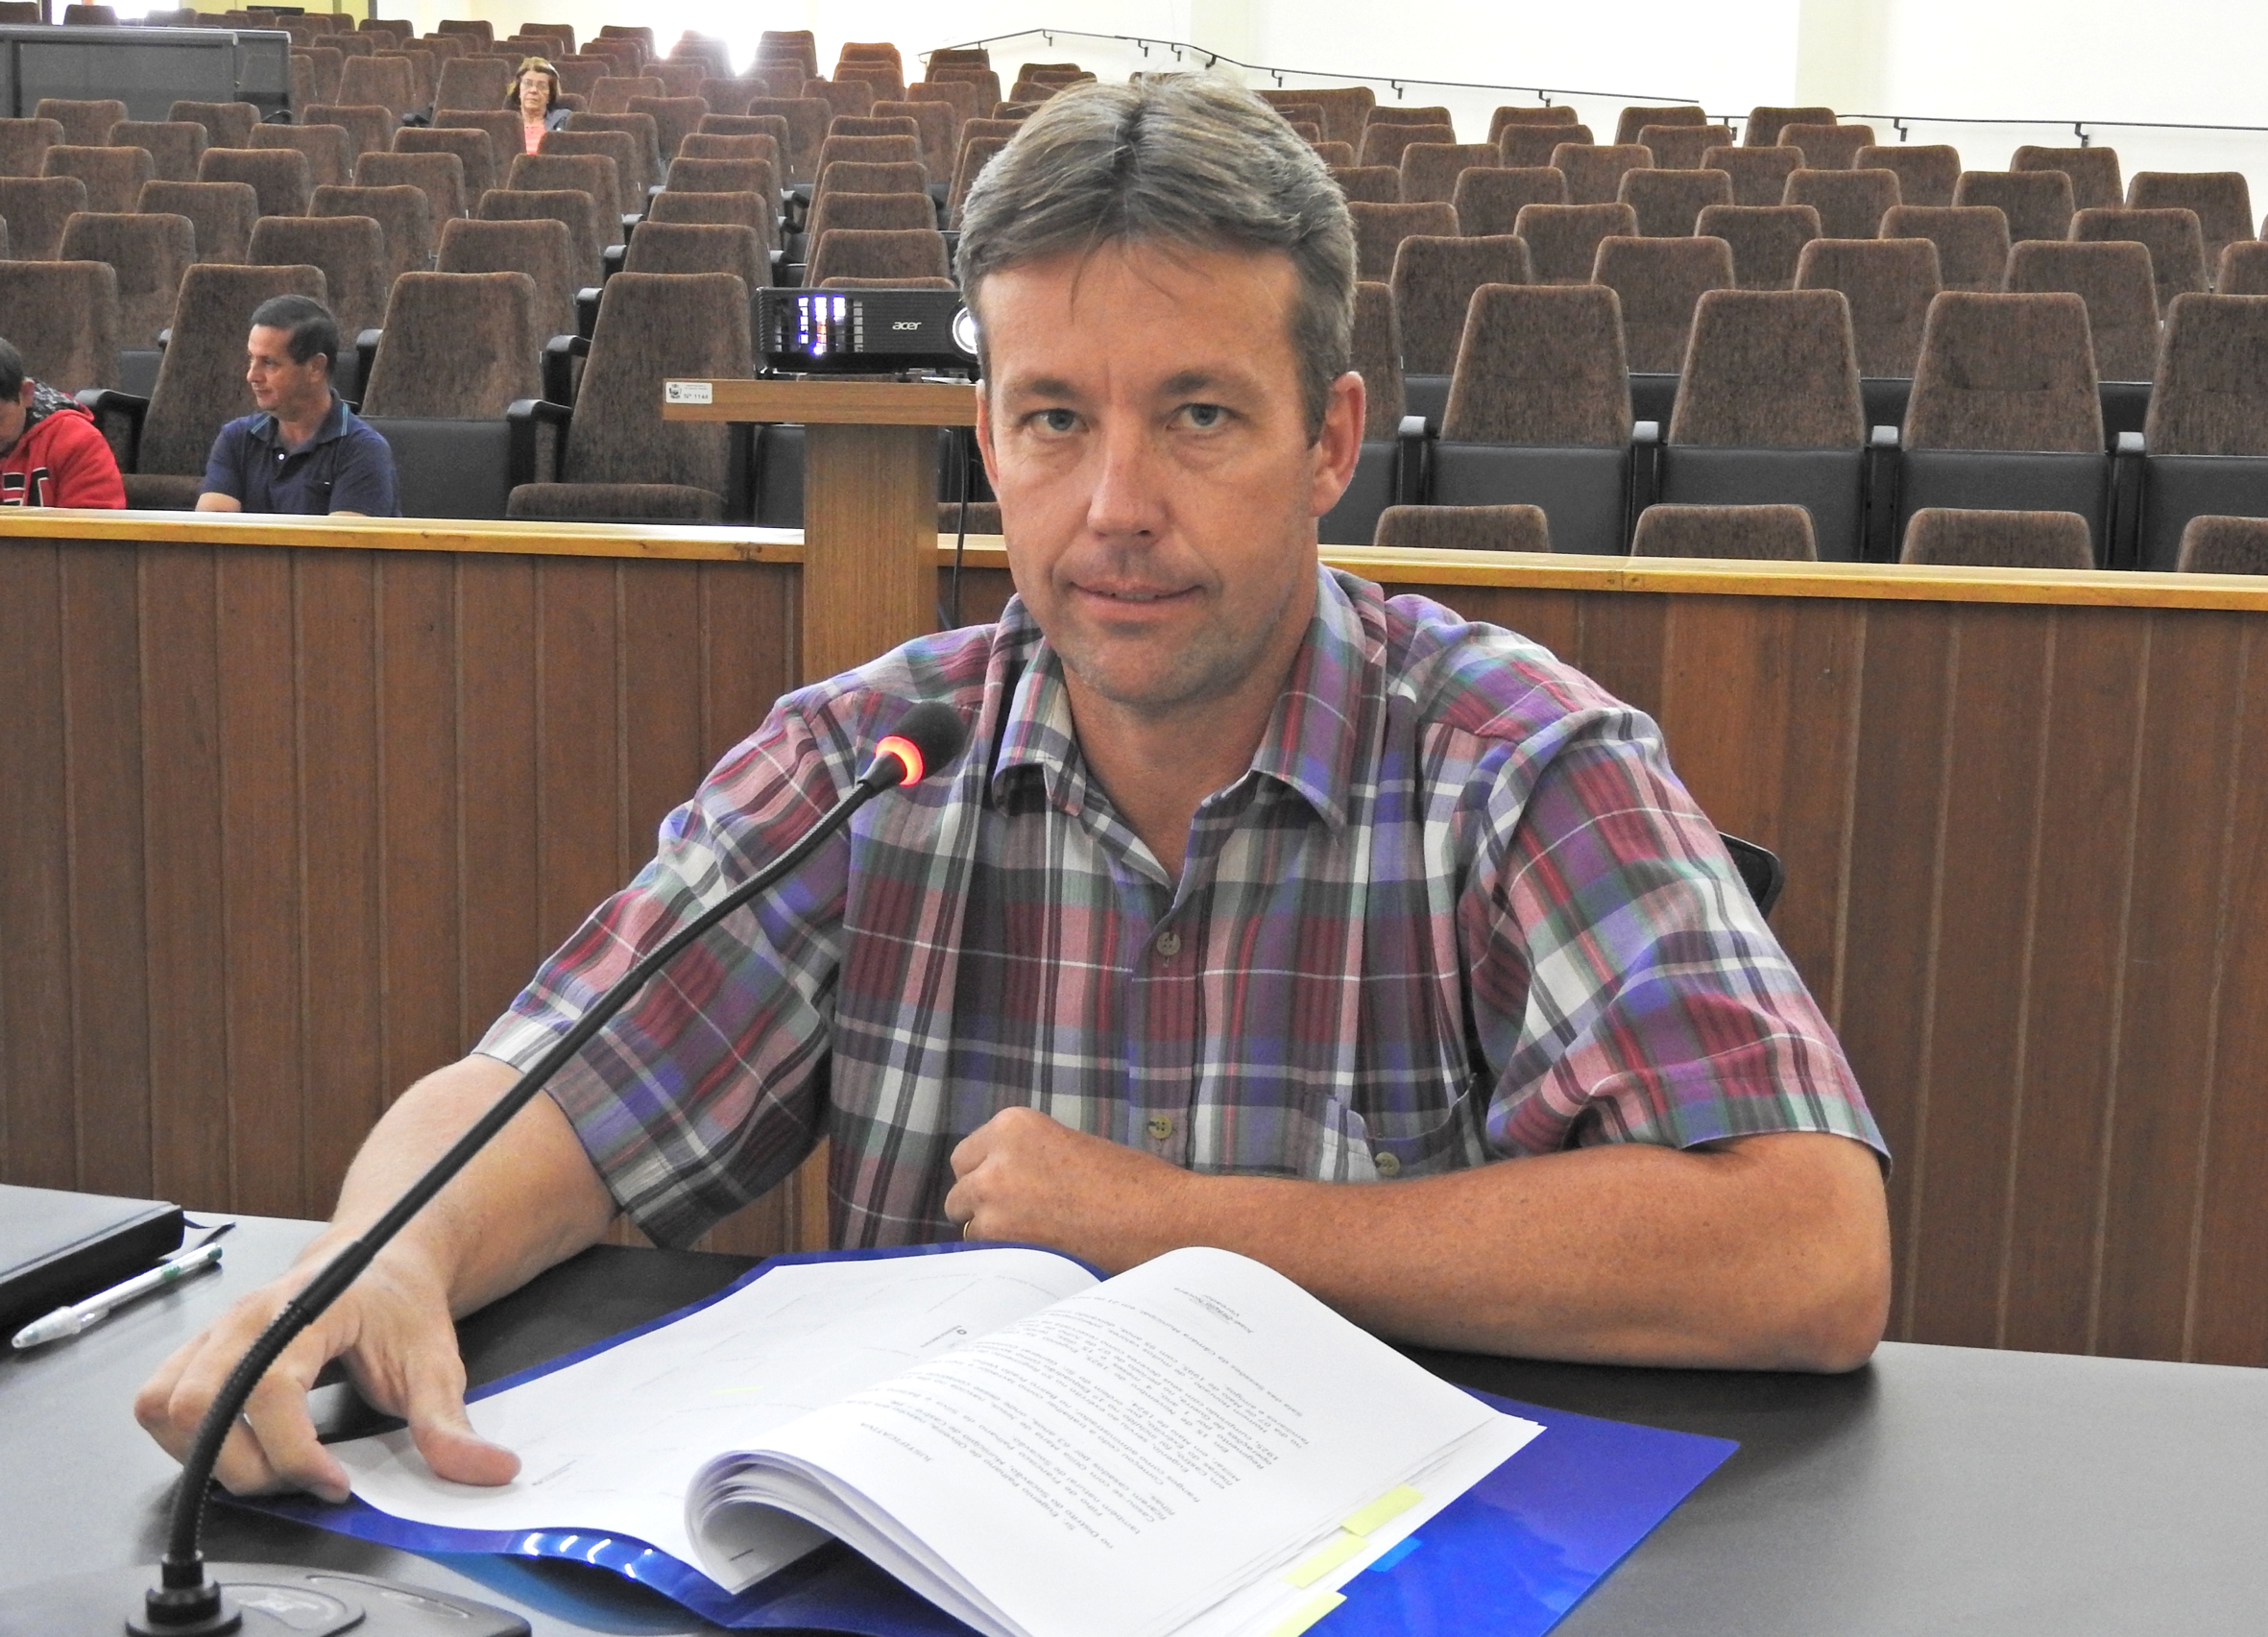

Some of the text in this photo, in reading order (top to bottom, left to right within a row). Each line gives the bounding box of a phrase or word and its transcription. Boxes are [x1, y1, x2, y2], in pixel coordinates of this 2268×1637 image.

[892, 322, 922, 330] acer
[1202, 1293, 1241, 1317] Vereador
[1121, 1326, 1143, 1340] anos,
[1182, 1333, 1217, 1356] Câmara
[1125, 1354, 1161, 1378] deveres
[1142, 1347, 1172, 1367] muitos
[1001, 1367, 1028, 1383] Prado
[1042, 1364, 1091, 1393] Esquadrão
[1111, 1362, 1141, 1382] meses
[1126, 1363, 1162, 1385] período
[1229, 1364, 1266, 1391] Sessões
[1028, 1381, 1057, 1400] Bairro
[1068, 1387, 1105, 1412] exército
[1093, 1384, 1123, 1405] ordem
[1129, 1383, 1176, 1415] Novembro
[1193, 1381, 1231, 1408] Honrado
[1224, 1384, 1257, 1408] amigos.
[915, 1408, 947, 1426] Castro
[1046, 1401, 1087, 1429] trabalhar
[1129, 1400, 1154, 1419] 1924.
[1179, 1395, 1211, 1421] Guerra,
[1231, 1408, 1267, 1433] Homem
[931, 1422, 968, 1449] Oliveira,
[1032, 1417, 1055, 1435] anos,
[1074, 1408, 1139, 1455] administrador,
[1119, 1422, 1148, 1442] serviu
[1121, 1413, 1158, 1439] incluído
[1147, 1420, 1185, 1450] Exército,
[1204, 1407, 1253, 1440] cumprindo
[1266, 1414, 1310, 1445] familiares
[858, 1422, 933, 1461] JUSTIFICATIVA
[961, 1433, 1005, 1465] Município
[977, 1424, 1015, 1450] Palhano
[1013, 1434, 1052, 1466] Socavão.
[1033, 1432, 1061, 1451] Maria
[1226, 1431, 1272, 1464] operações
[1152, 1443, 1190, 1473] Eugenio,
[1216, 1433, 1265, 1470] Regimento
[1253, 1440, 1279, 1461] 1925,
[982, 1458, 1020, 1487] Palhano
[1017, 1451, 1061, 1484] Francisco
[1092, 1462, 1129, 1490] casados
[1121, 1453, 1165, 1485] Começou
[1176, 1451, 1208, 1477] Castro,
[1201, 1462, 1233, 1486] fileiras
[1212, 1457, 1241, 1481] Militar,
[1009, 1464, 1050, 1498] Socavão,
[1064, 1477, 1100, 1502] natural
[1165, 1475, 1200, 1503] frangos
[1021, 1487, 1060, 1517] Eugenio
[1078, 1498, 1103, 1516] Filho
[1131, 1492, 1167, 1521] ficaram
[1063, 1509, 1099, 1537] Distrito
[1100, 1503, 1141, 1534] também
